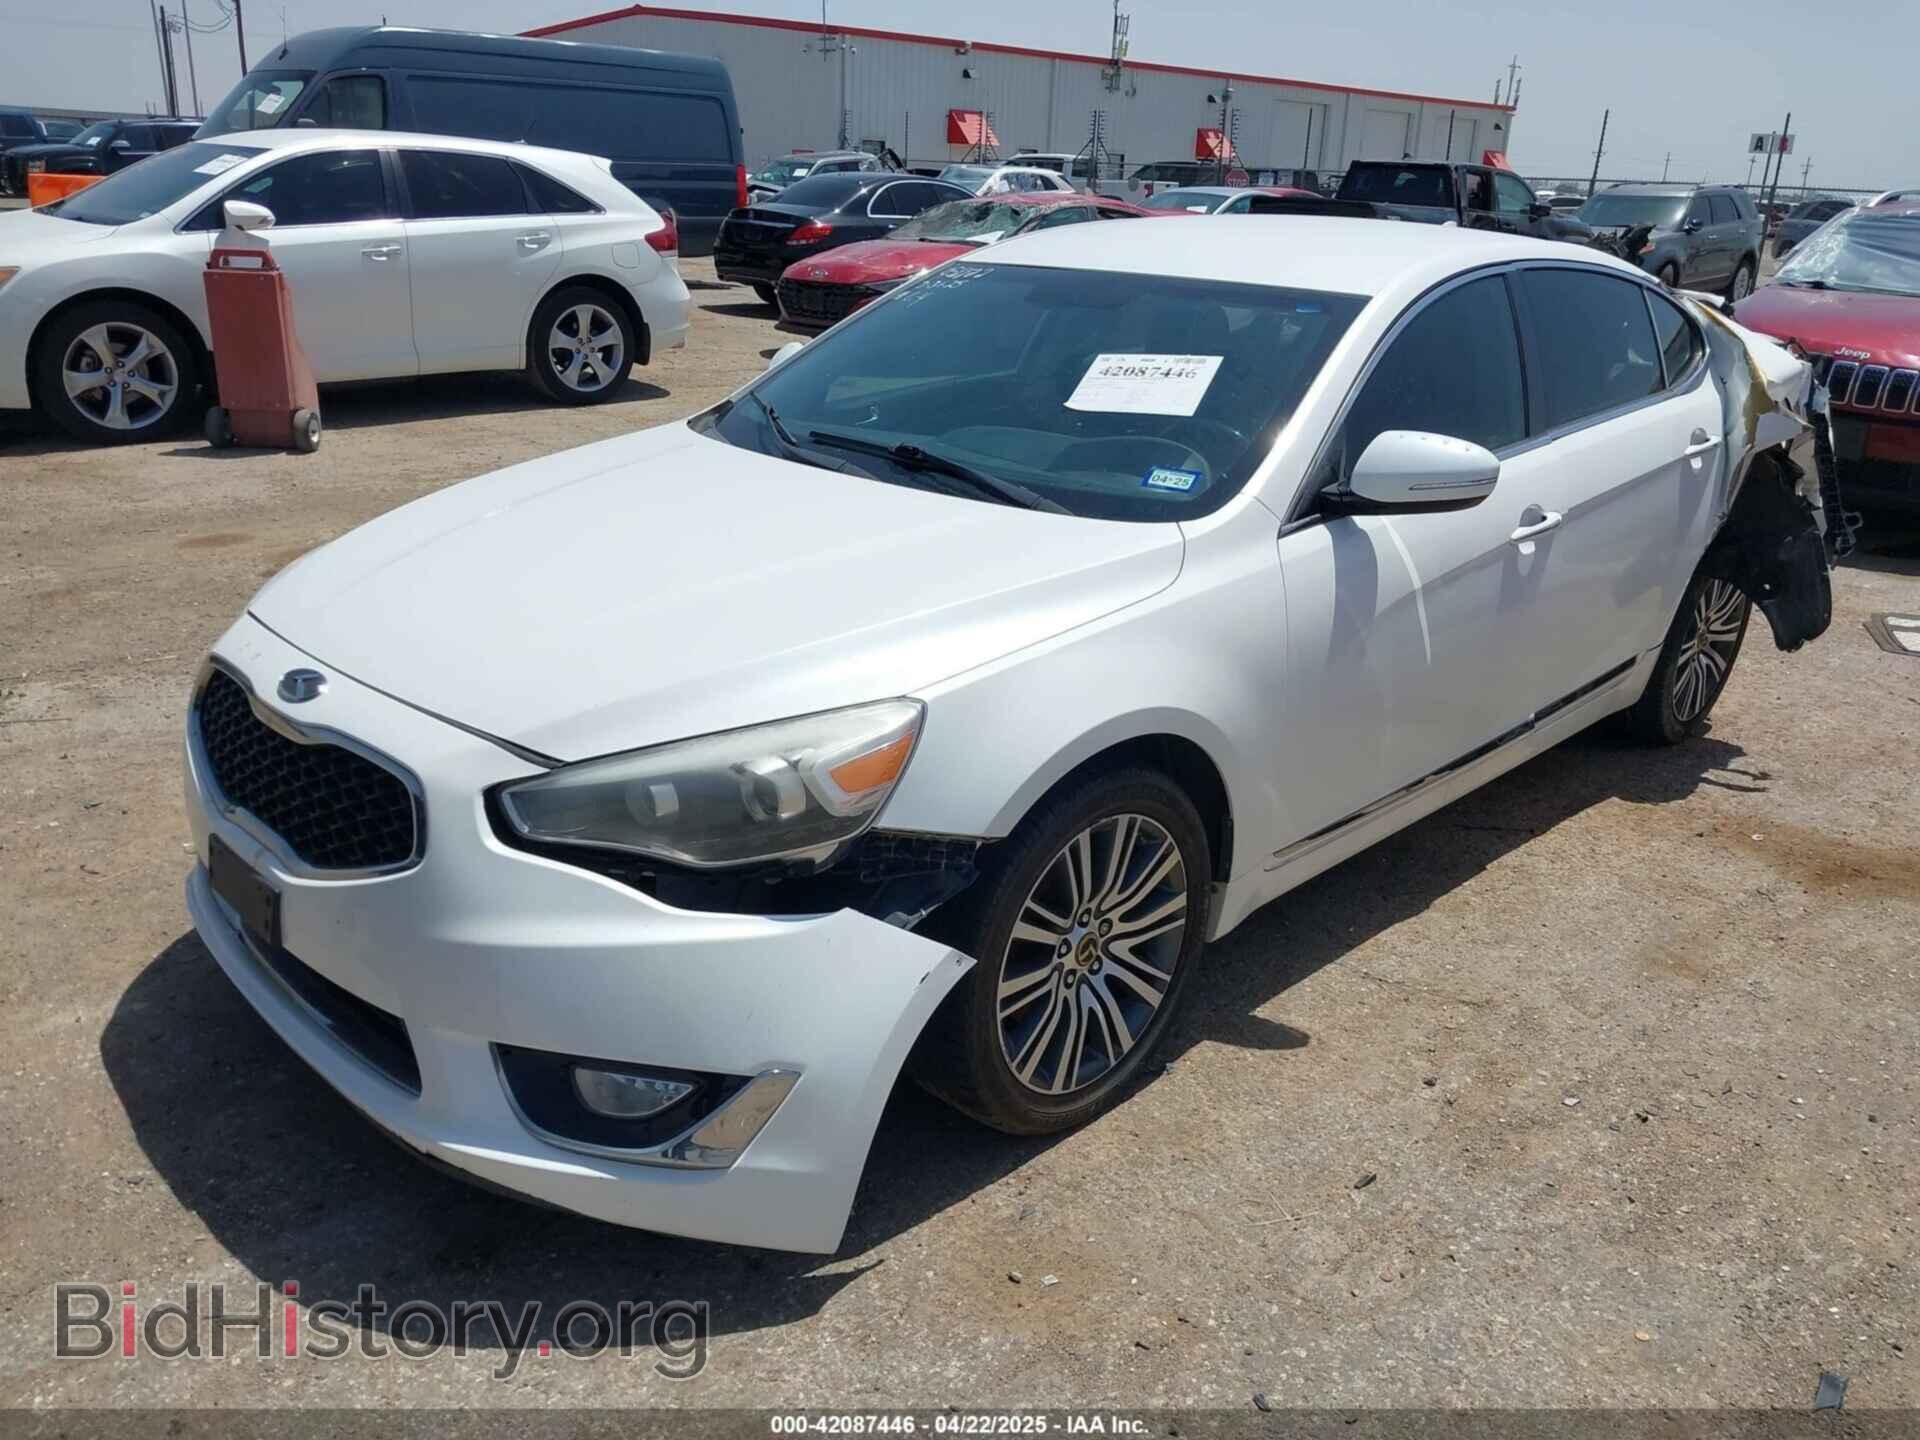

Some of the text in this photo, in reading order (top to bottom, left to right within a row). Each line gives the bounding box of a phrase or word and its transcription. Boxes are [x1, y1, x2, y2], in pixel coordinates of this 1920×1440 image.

[1754, 136, 1764, 151] A
[1834, 347, 1871, 359] Jeep
[1098, 366, 1198, 379] 42087446
